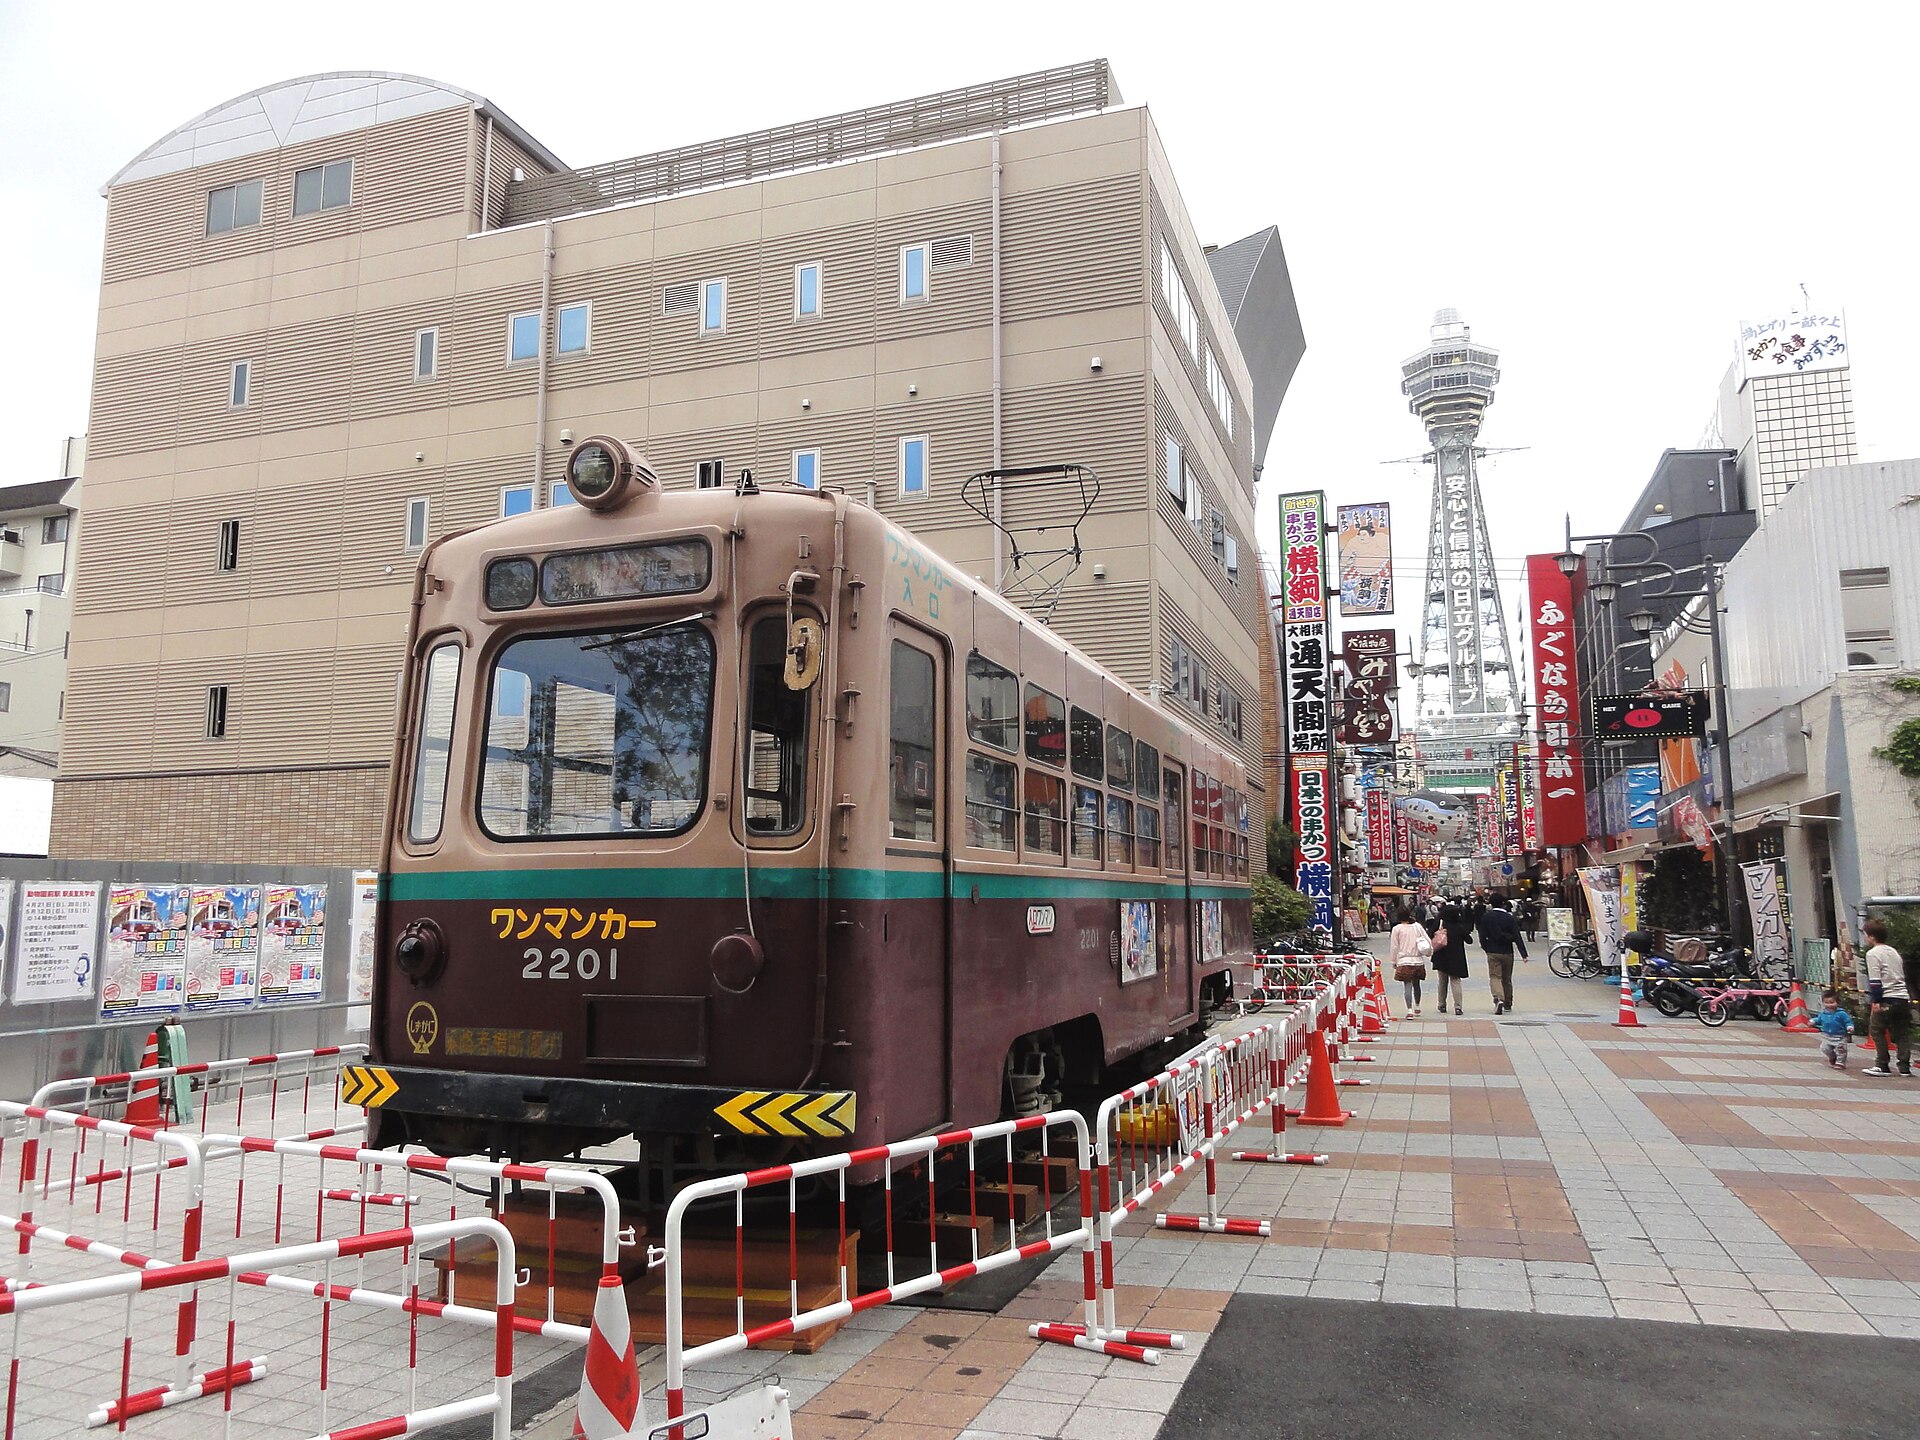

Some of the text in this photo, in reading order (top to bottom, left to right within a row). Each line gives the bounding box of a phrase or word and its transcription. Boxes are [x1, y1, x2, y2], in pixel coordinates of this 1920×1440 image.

[1285, 497, 1317, 510] 新世界
[1287, 545, 1320, 604] 横綱
[1288, 606, 1321, 620] 通天閣店
[1288, 623, 1323, 638] 大相撲
[1290, 638, 1325, 732] 通天閣
[1292, 733, 1327, 752] 場所
[491, 907, 657, 940] ワンマンカー
[1080, 928, 1100, 950] 2201
[522, 947, 617, 980] 2201
